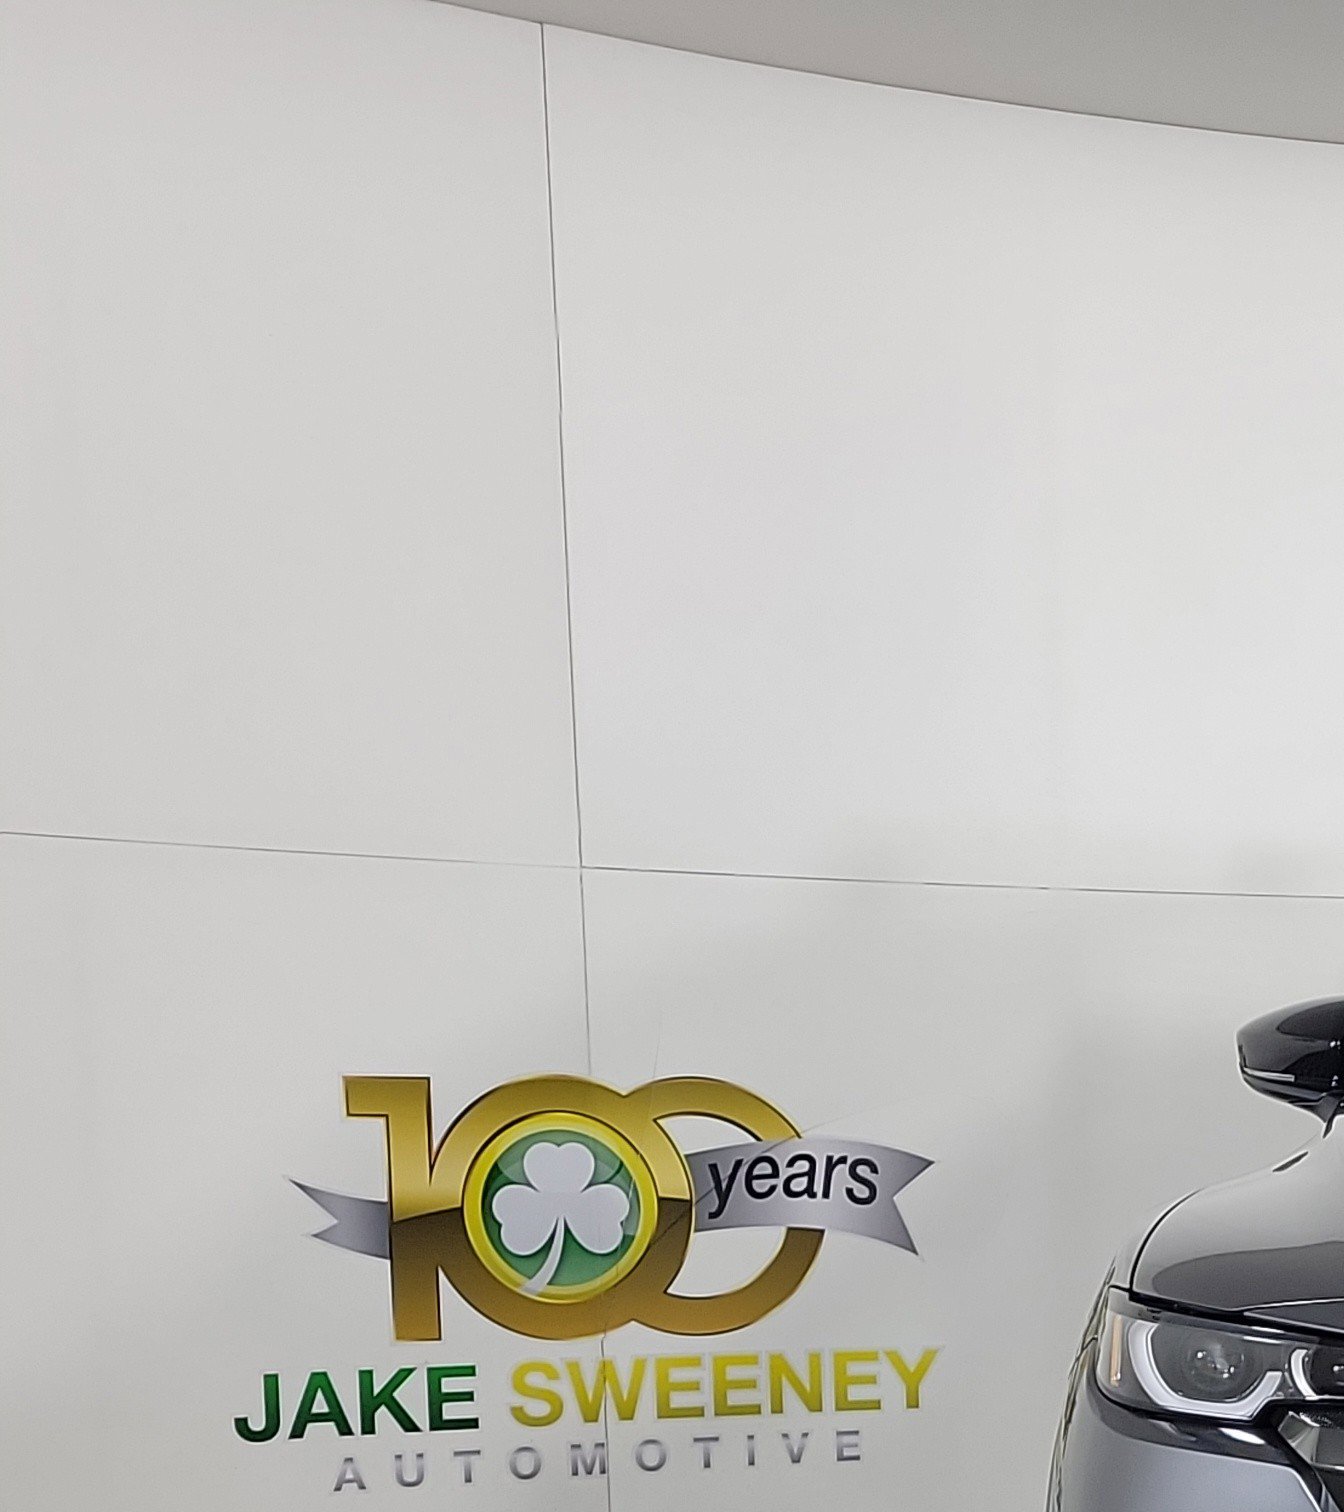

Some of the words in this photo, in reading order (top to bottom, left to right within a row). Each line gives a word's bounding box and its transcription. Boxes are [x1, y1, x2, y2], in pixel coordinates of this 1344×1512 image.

[344, 1075, 825, 1340] 100
[708, 1151, 879, 1219] years
[233, 1365, 480, 1443] JAKE
[509, 1348, 940, 1427] SWEENEY
[333, 1431, 861, 1492] AUTOMOTIVE
